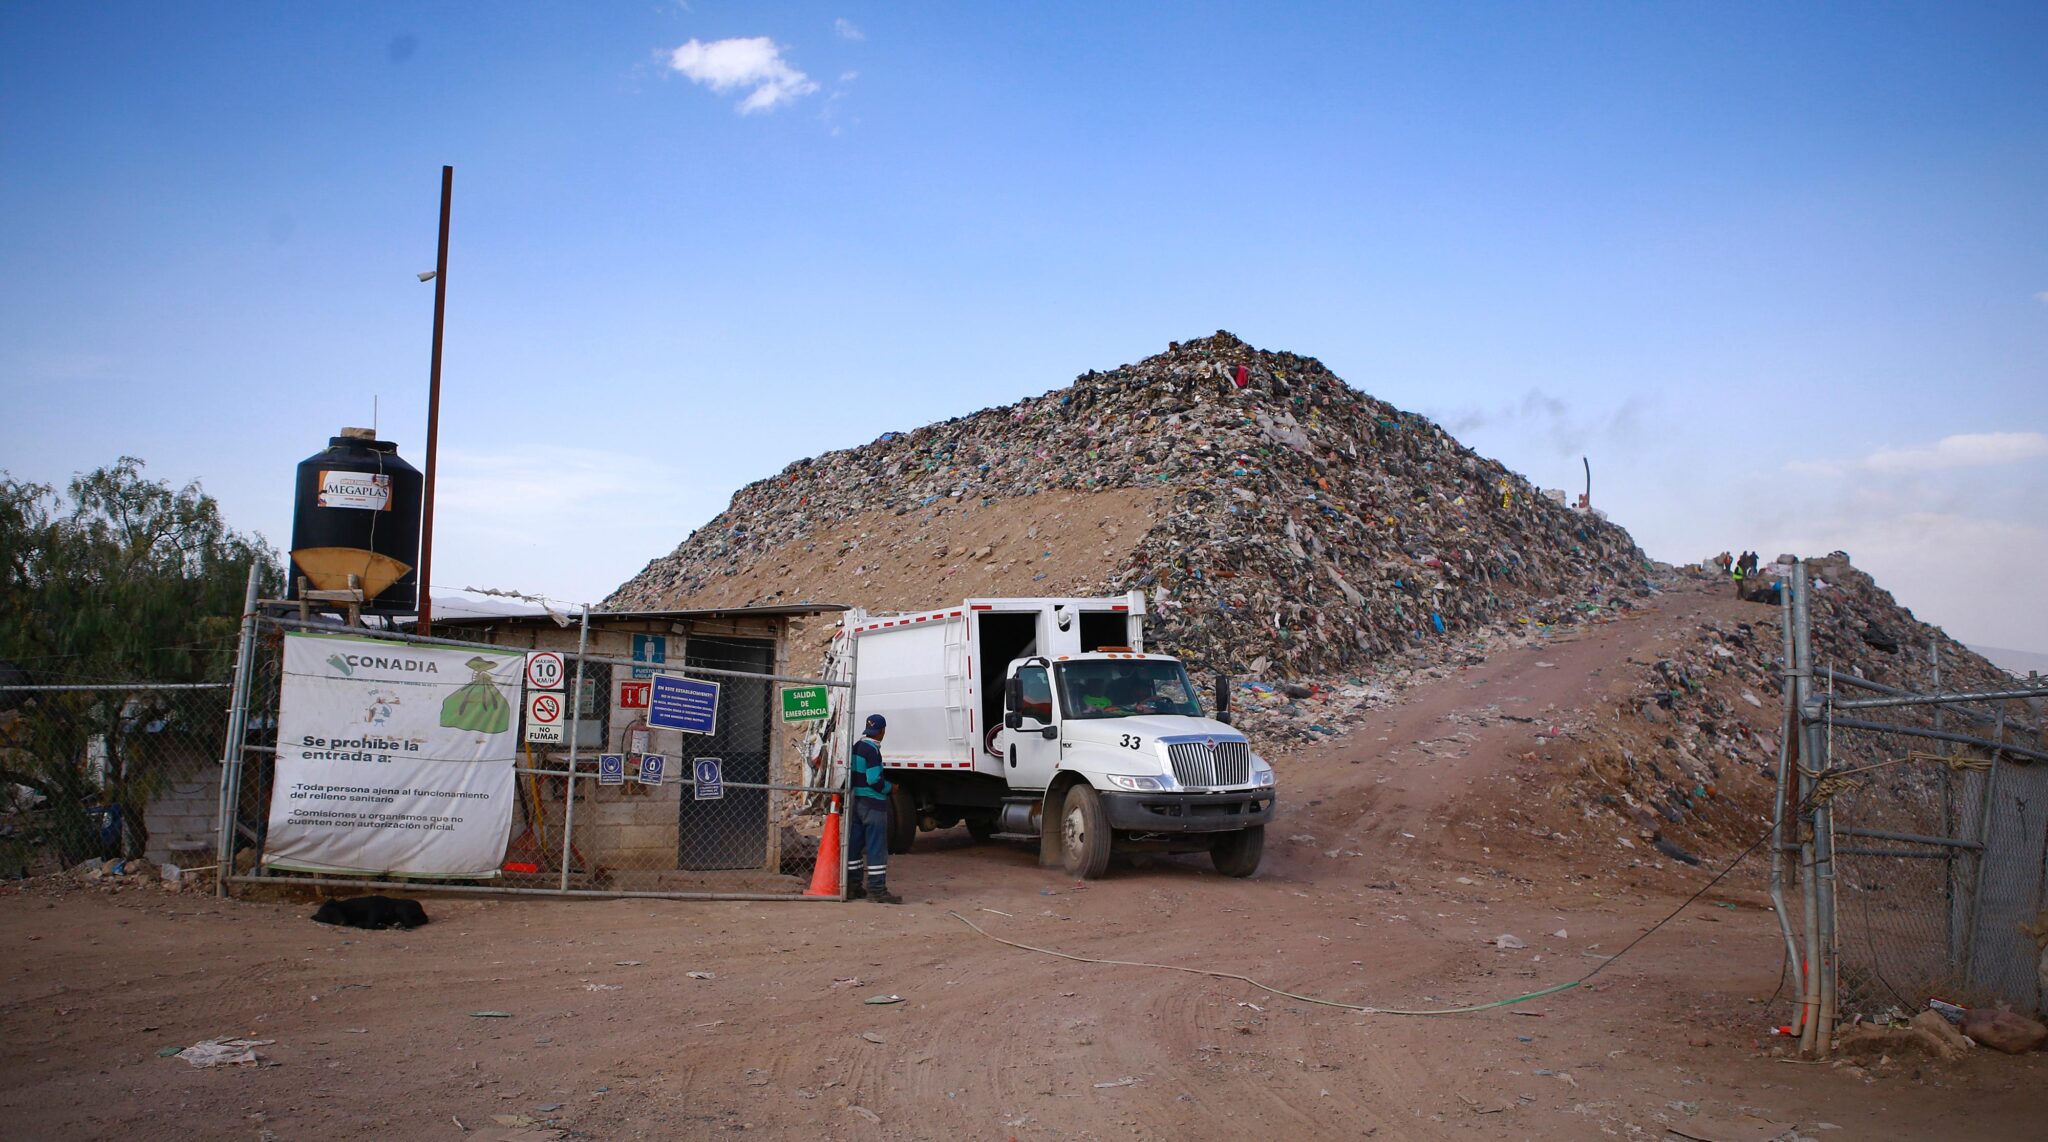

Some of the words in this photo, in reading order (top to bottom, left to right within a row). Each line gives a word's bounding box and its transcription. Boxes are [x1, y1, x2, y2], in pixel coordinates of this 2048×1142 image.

[328, 484, 388, 497] MEGAPLAS
[345, 655, 439, 674] CONADIA
[536, 664, 557, 678] 10
[793, 690, 817, 699] SALIDA
[800, 700, 810, 708] DE
[785, 707, 828, 718] EMERGENCIA
[529, 732, 559, 740] FUMAR
[1119, 733, 1142, 751] 33
[303, 735, 326, 748] Se
[404, 740, 419, 752] la
[302, 750, 373, 763] entrada
[378, 754, 392, 764] a:
[290, 791, 307, 799] del
[309, 792, 347, 801] relleno
[349, 795, 395, 804] sanitario
[326, 785, 370, 794] persona
[372, 787, 400, 796] ajena
[402, 788, 411, 796] al
[414, 788, 490, 800] funcionamiento
[287, 818, 333, 827] cuenten
[335, 819, 355, 828] con
[357, 821, 421, 830] autorización
[423, 823, 456, 832] oficial.
[368, 813, 428, 822] organismos
[430, 815, 449, 823] que
[451, 816, 464, 824] no
